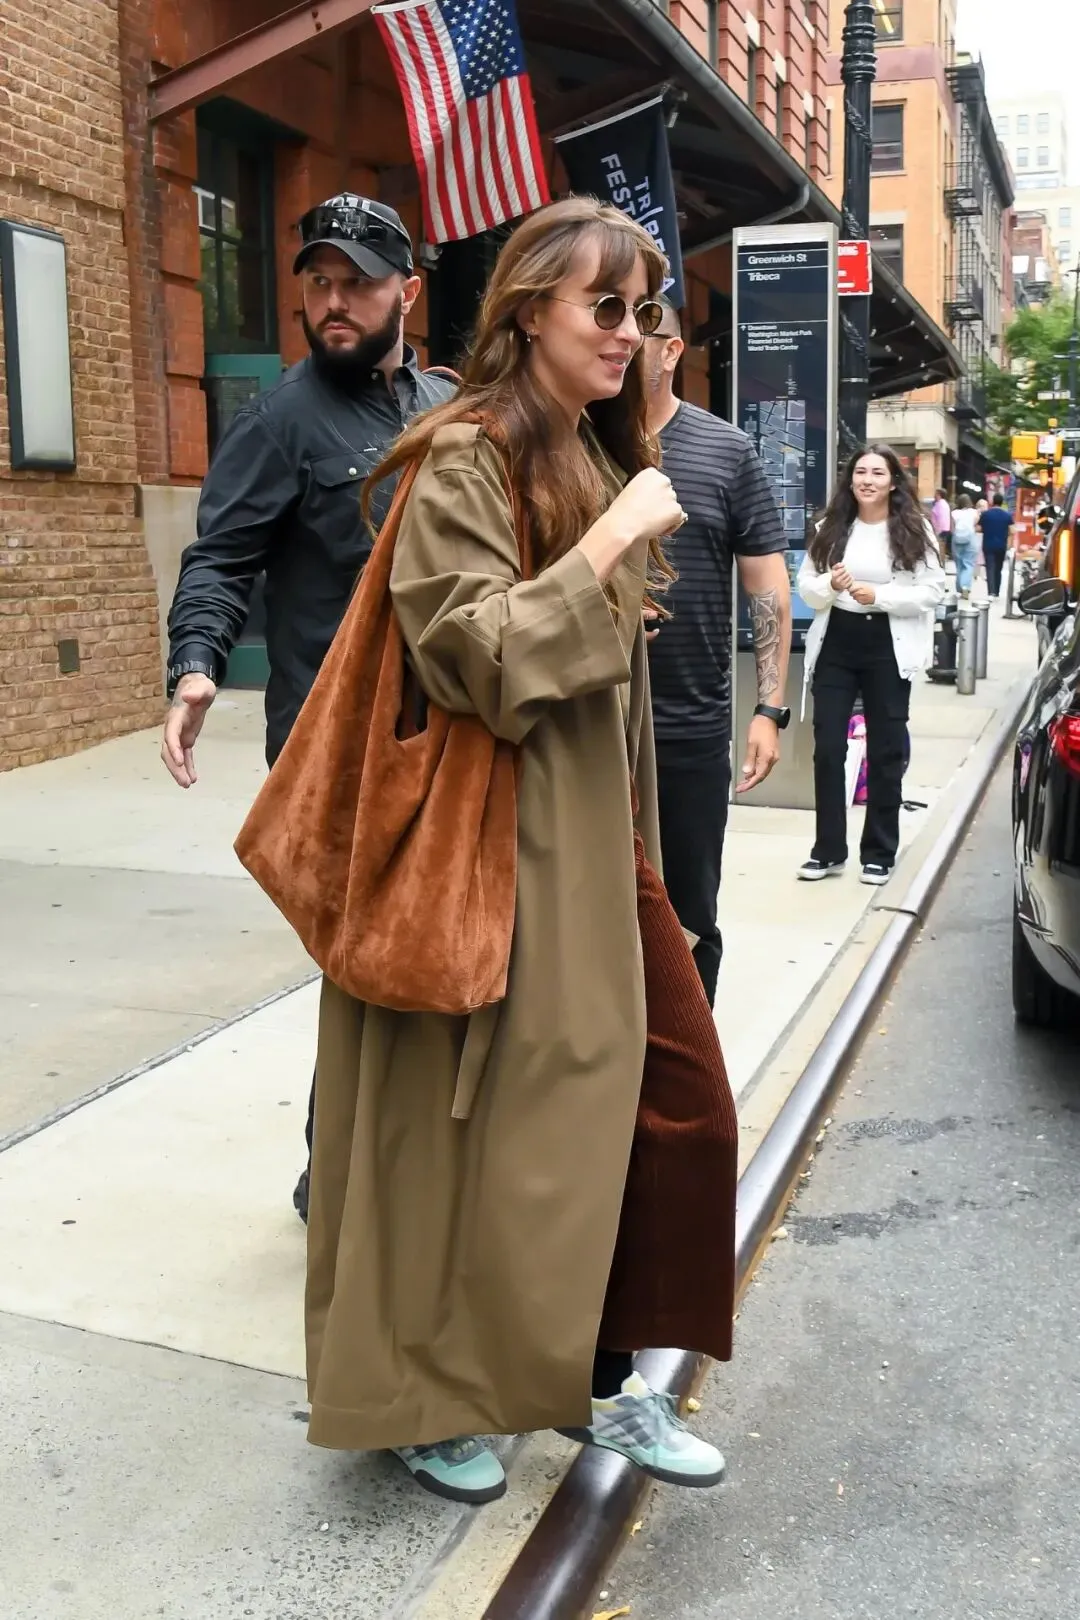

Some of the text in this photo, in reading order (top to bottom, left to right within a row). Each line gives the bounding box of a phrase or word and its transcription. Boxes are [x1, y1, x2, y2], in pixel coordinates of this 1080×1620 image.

[748, 253, 807, 265] Greenwich St
[748, 272, 780, 281] Tribeca
